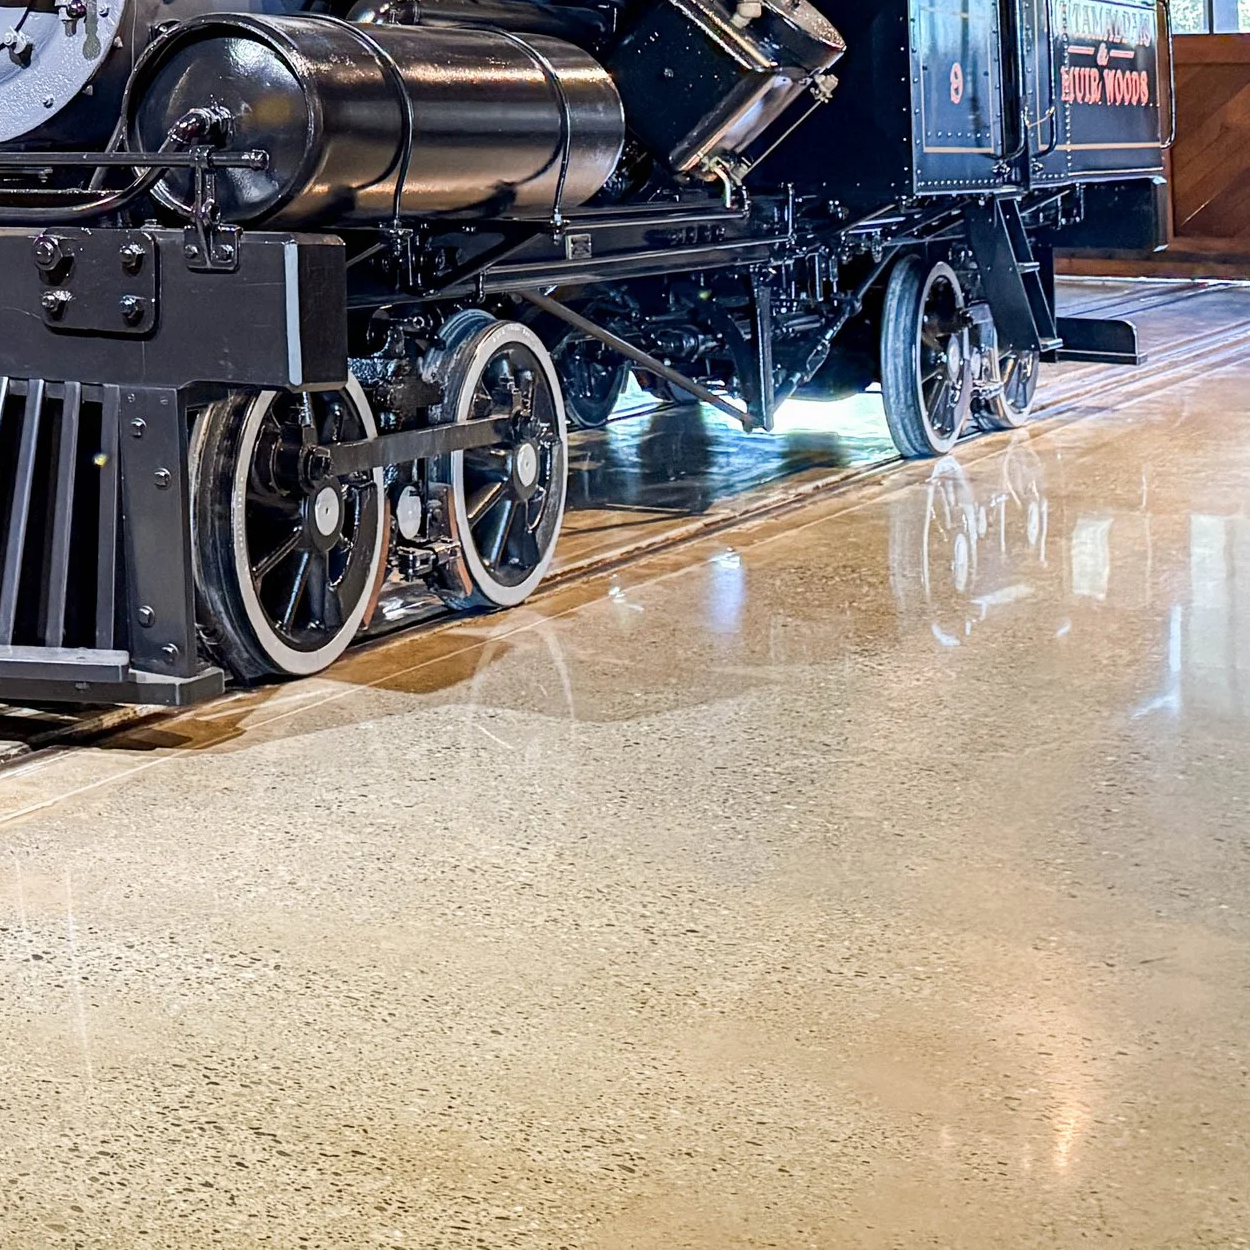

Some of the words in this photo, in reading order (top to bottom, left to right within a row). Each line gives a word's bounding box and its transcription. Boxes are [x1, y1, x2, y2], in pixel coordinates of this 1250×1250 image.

[1096, 41, 1110, 67] &
[950, 61, 964, 104] 9
[1060, 65, 1103, 104] MUIR
[1103, 68, 1149, 107] WOODS
